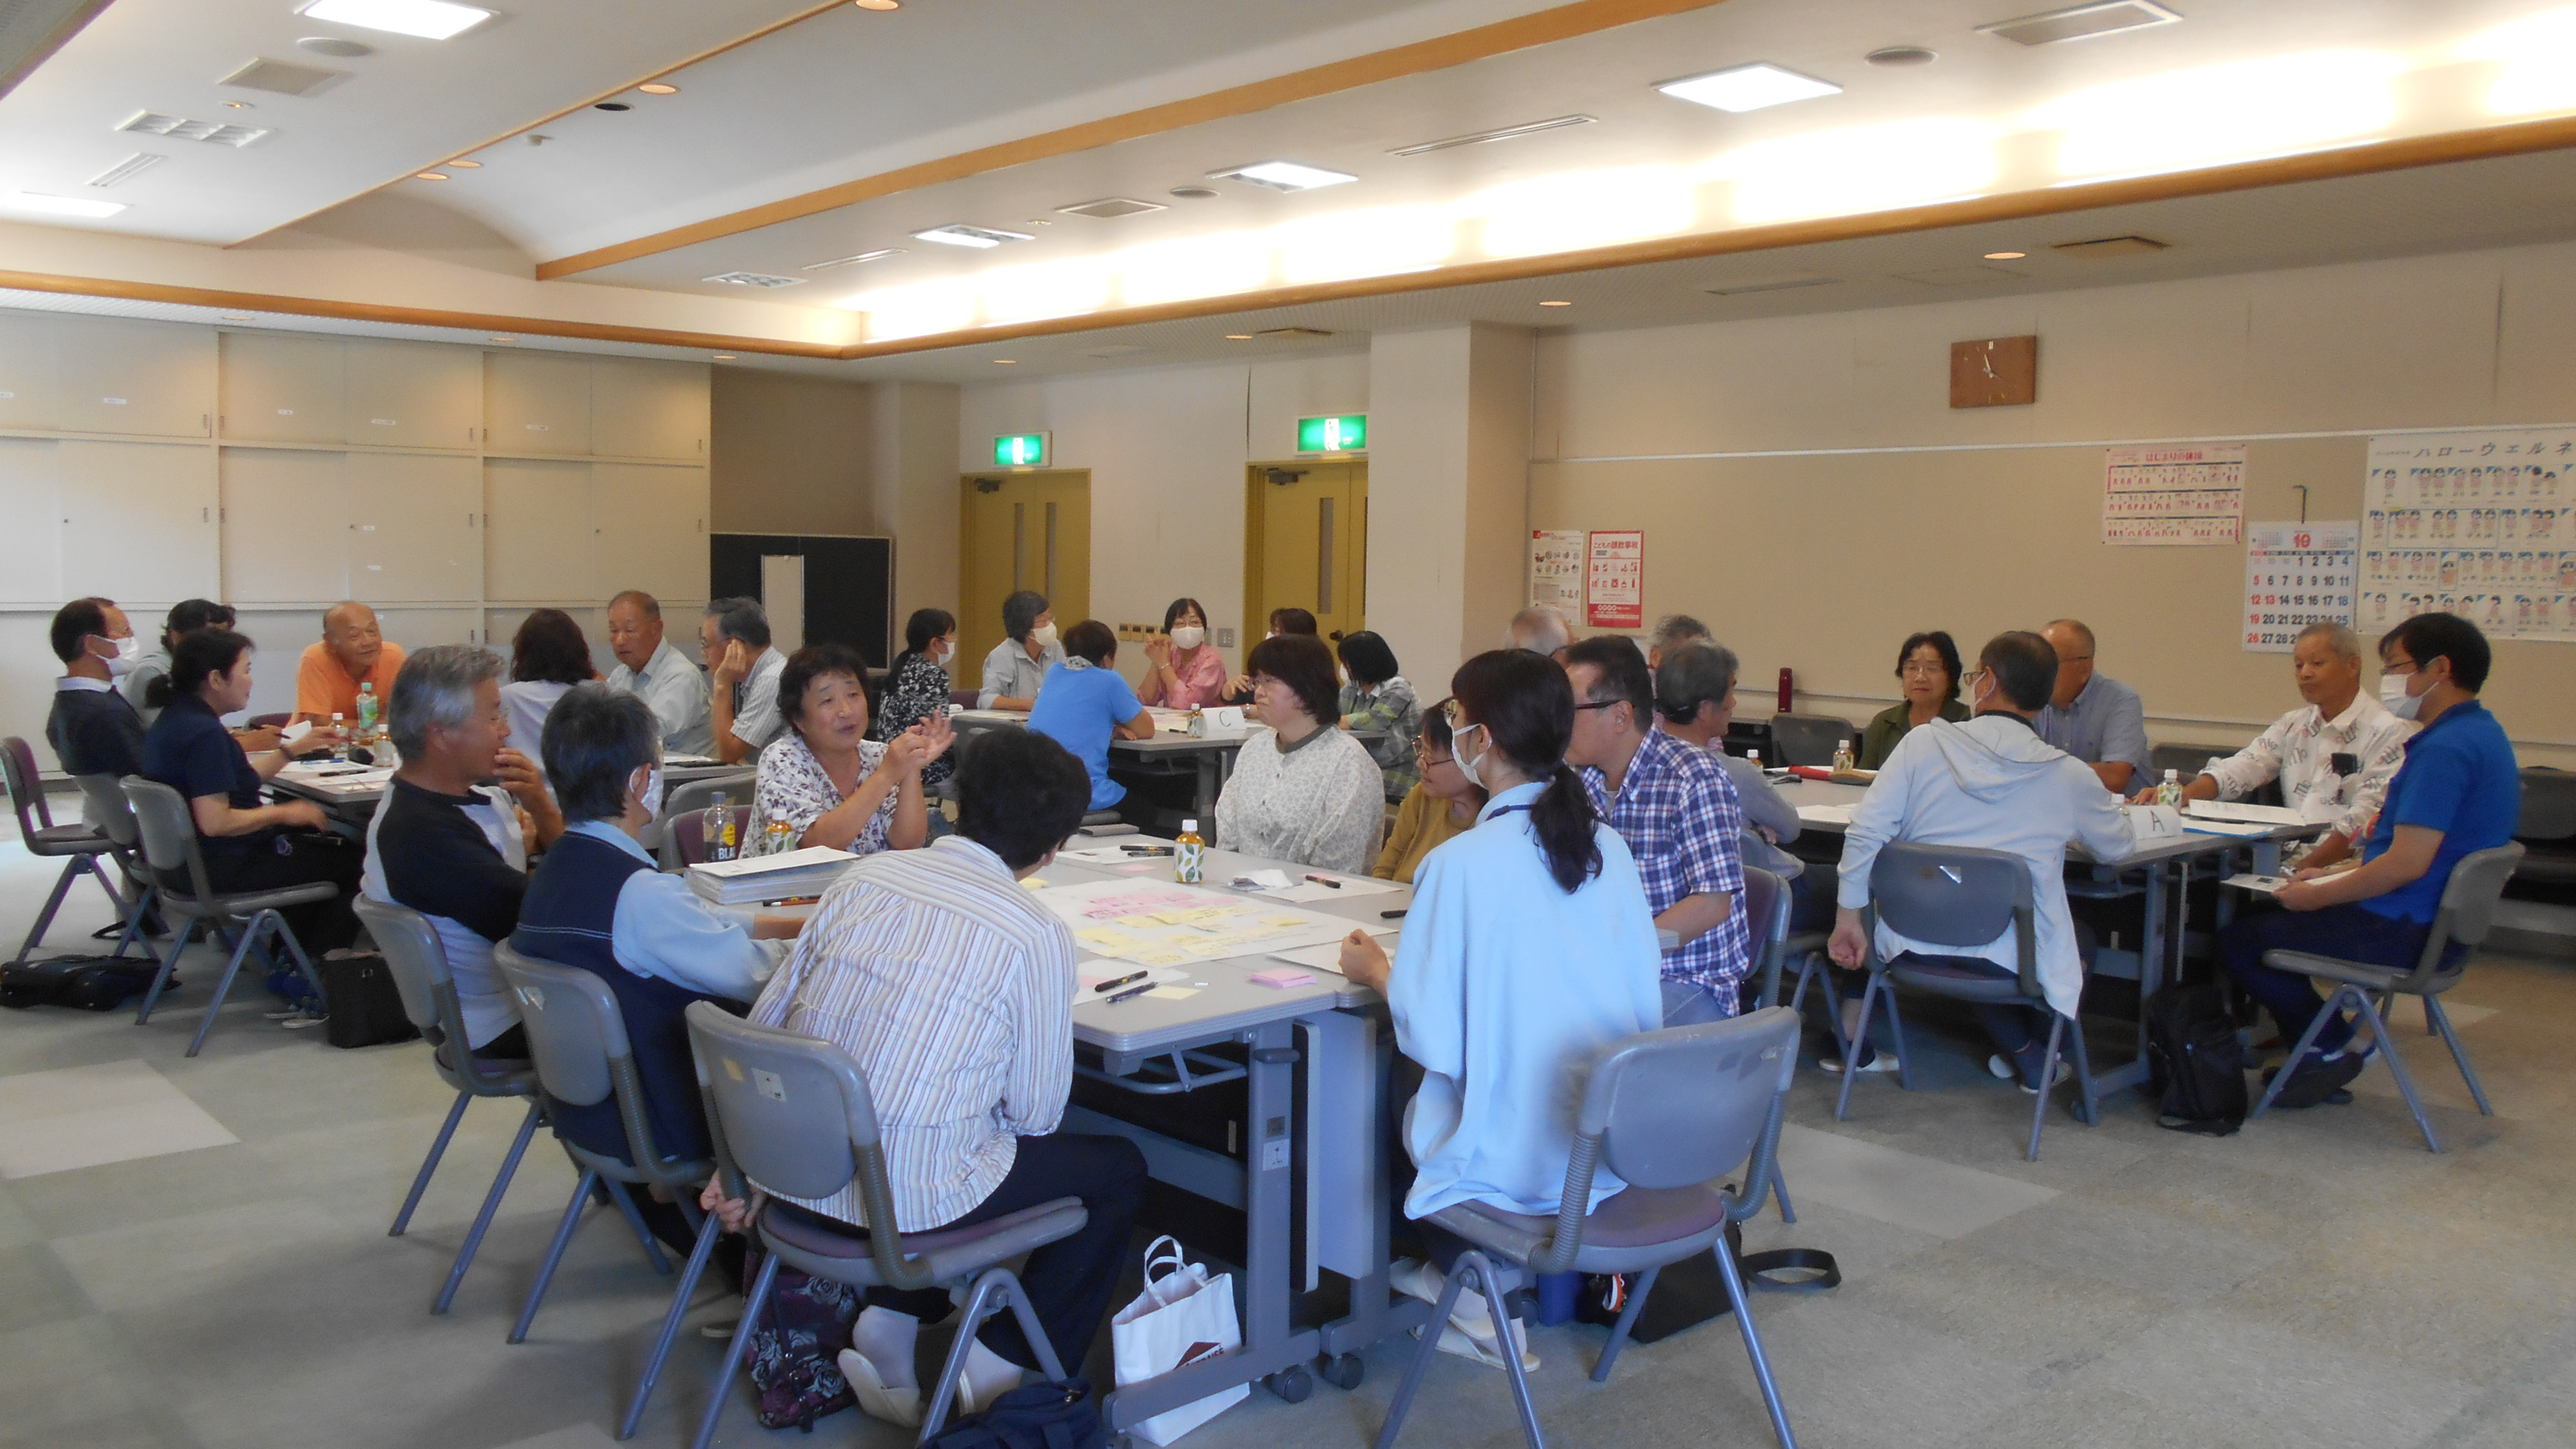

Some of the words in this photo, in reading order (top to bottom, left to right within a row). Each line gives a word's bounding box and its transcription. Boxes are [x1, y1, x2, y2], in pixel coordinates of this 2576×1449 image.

[2293, 533, 2311, 548] 10
[2298, 556, 2303, 566] 1
[2312, 556, 2319, 566] 2
[2327, 556, 2333, 566] 3
[2342, 556, 2349, 566] 4
[2253, 576, 2260, 586] 5
[2268, 576, 2274, 586] 6
[2283, 576, 2289, 586] 7
[2296, 576, 2303, 586] 8
[2311, 576, 2317, 586] 9
[2324, 576, 2334, 586] 10
[2339, 576, 2349, 586] 11
[2250, 595, 2261, 605] 12
[2265, 595, 2275, 605] 13
[2279, 595, 2289, 605] 14
[2293, 595, 2304, 605] 15
[2307, 595, 2318, 605] 16
[2323, 595, 2333, 605] 17
[2338, 595, 2348, 605] 18
[2249, 614, 2260, 624] 19
[2263, 614, 2275, 624] 20
[2278, 614, 2288, 624] 21
[2291, 614, 2303, 624] 22
[2247, 633, 2259, 643] 26
[2262, 633, 2274, 643] 27
[2276, 633, 2288, 643] 28
[2290, 634, 2297, 643] 2
[1219, 710, 1231, 727] C
[2150, 809, 2165, 832] A
